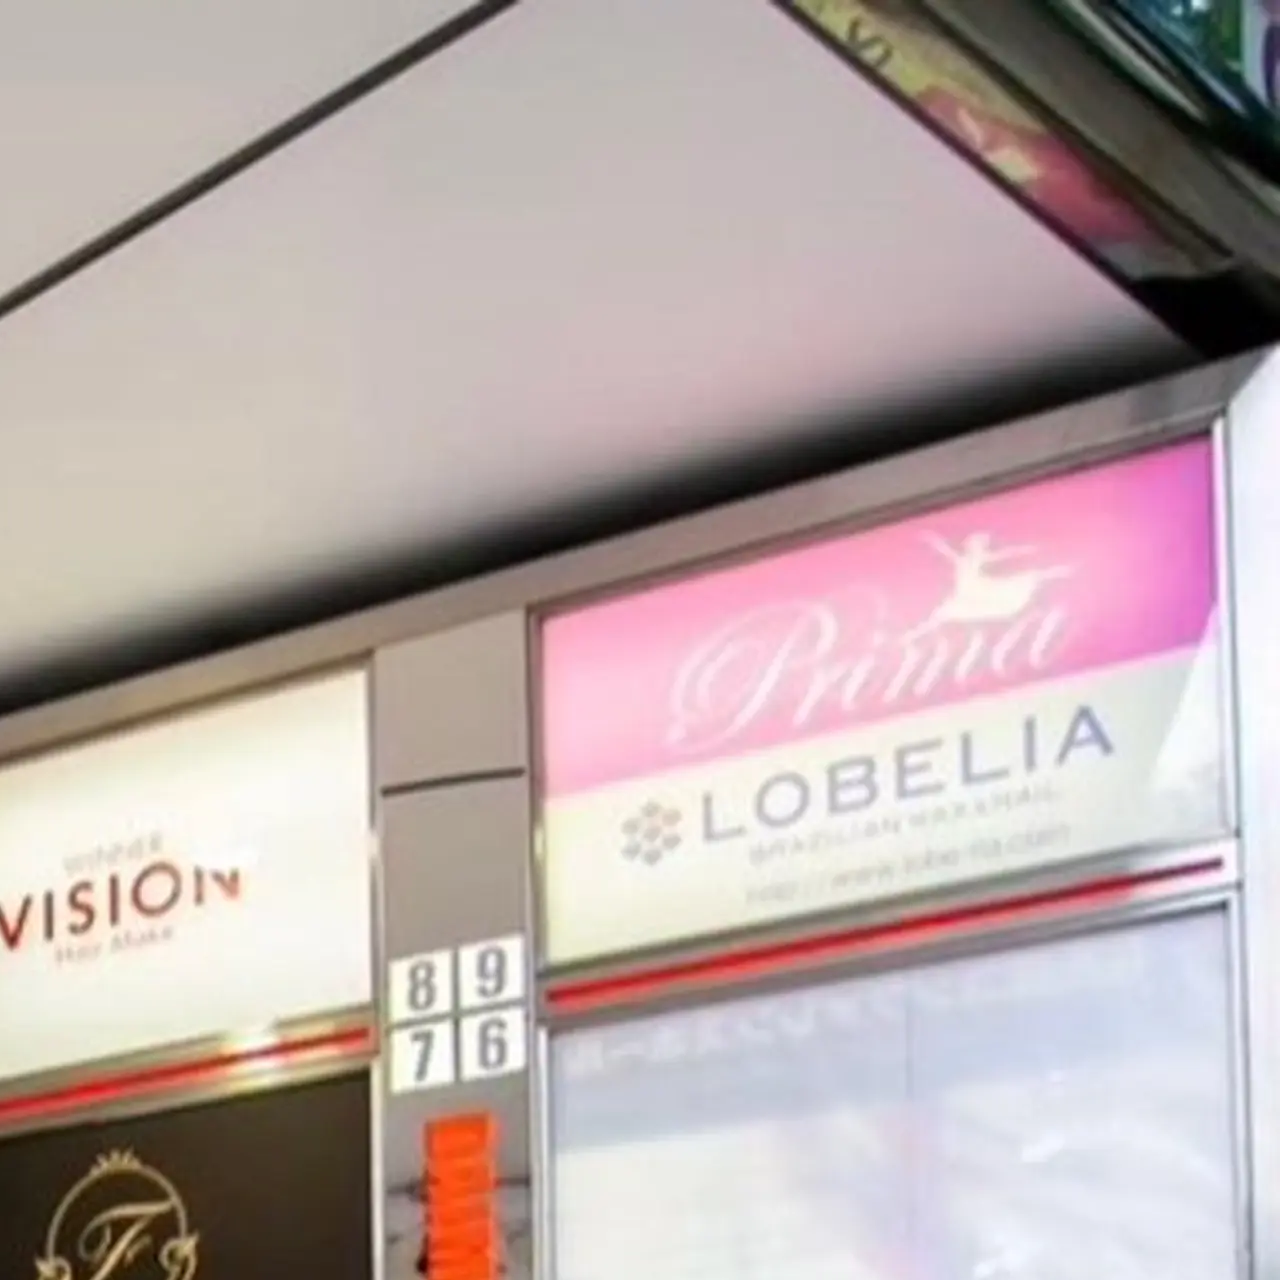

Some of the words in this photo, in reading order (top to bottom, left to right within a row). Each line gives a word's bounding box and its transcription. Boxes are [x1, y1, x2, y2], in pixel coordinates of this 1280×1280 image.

[665, 592, 1072, 747] Prima
[701, 704, 1114, 843] LOBELIA
[406, 960, 436, 1011] 8
[476, 947, 506, 998] 9
[408, 1030, 436, 1080] 7
[478, 1019, 508, 1069] 6
